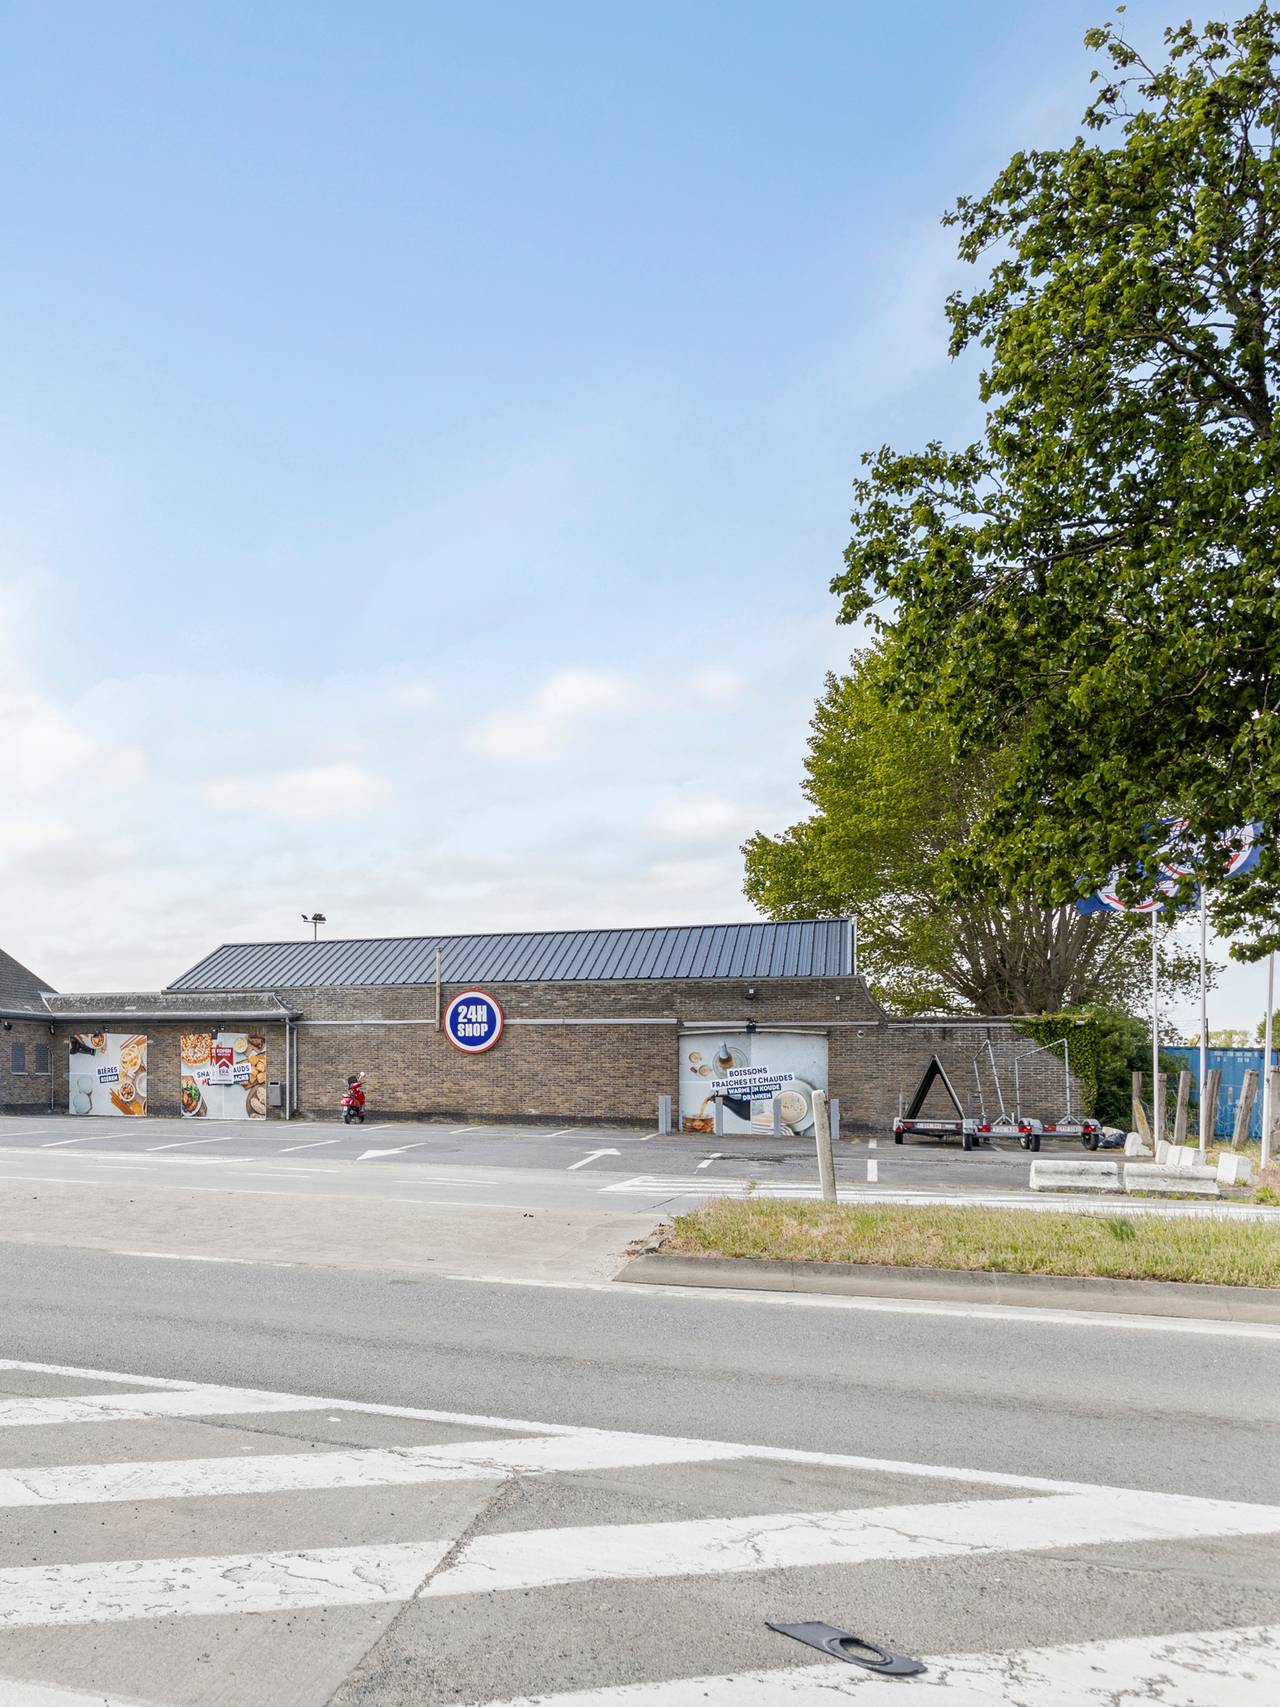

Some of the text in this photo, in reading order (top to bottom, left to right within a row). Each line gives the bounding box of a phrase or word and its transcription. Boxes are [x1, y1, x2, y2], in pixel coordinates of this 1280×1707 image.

[458, 1005, 487, 1022] 24H
[457, 1023, 488, 1037] SHOP
[97, 1067, 118, 1075] BIÈRES
[729, 1068, 768, 1078] BOISSONS
[757, 1074, 793, 1084] CHAUDES
[728, 1086, 750, 1094] WARME
[759, 1084, 780, 1092] KOUDE
[742, 1093, 771, 1101] DRANKEN
